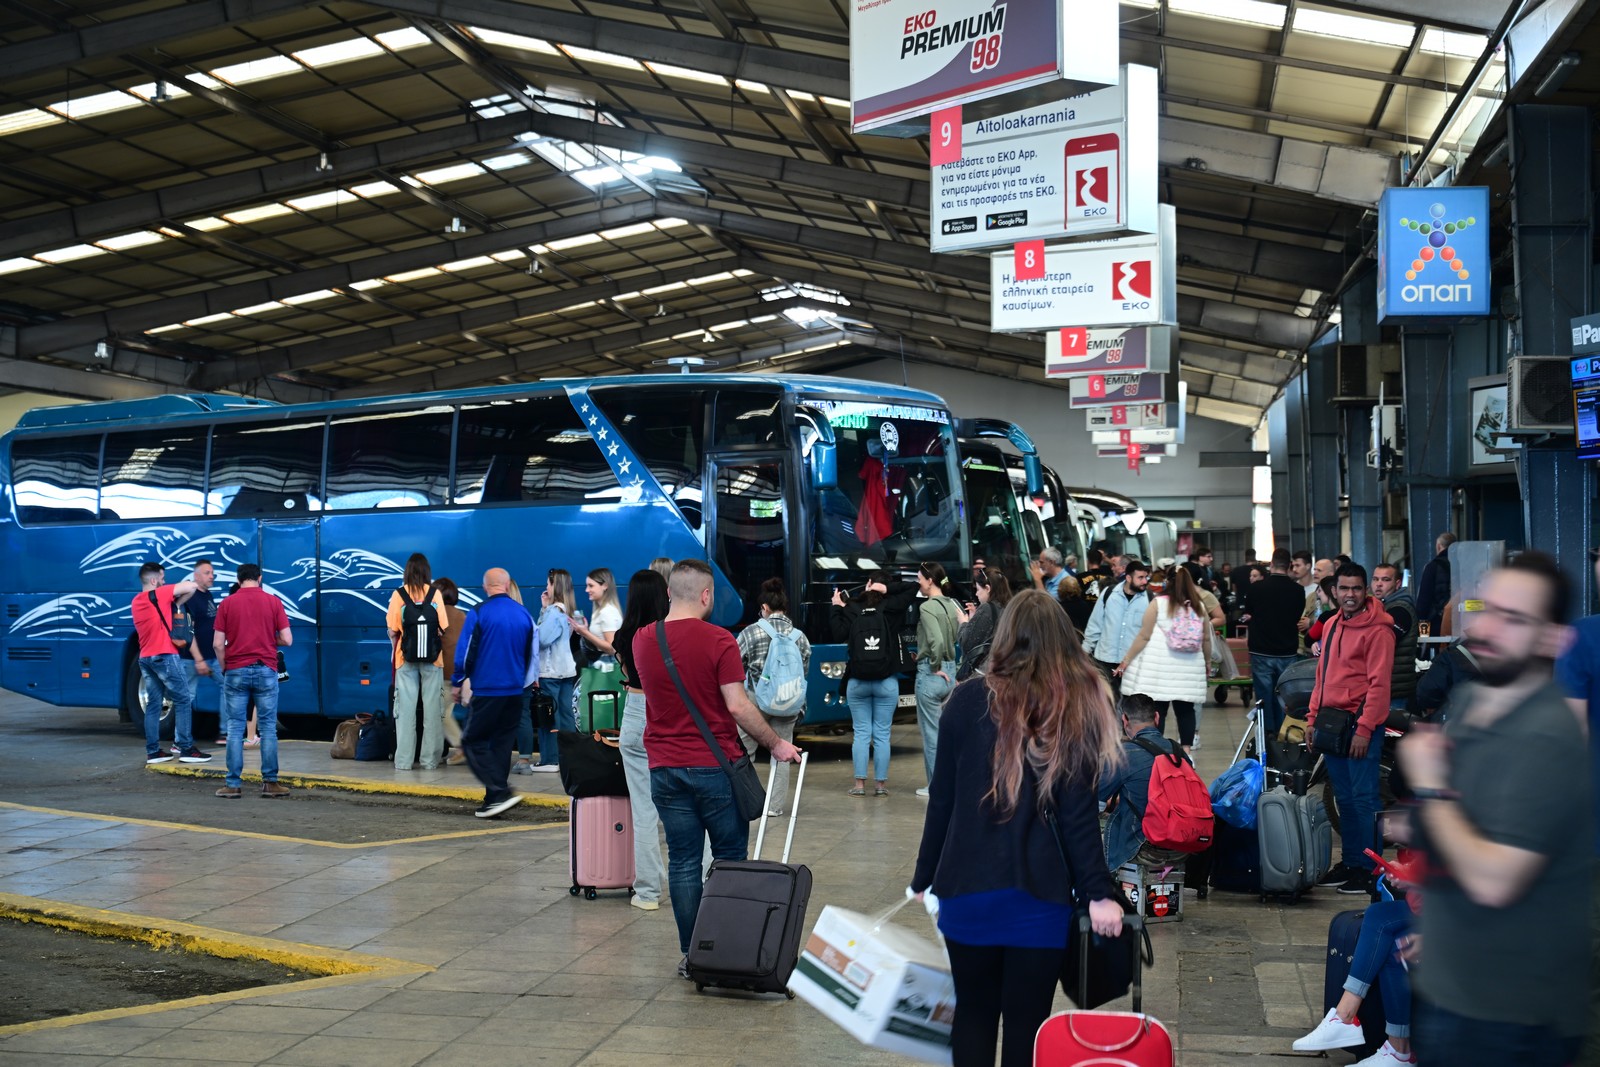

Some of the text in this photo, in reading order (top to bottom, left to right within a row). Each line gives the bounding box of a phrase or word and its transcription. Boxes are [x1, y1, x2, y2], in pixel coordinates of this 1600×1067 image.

[903, 9, 937, 35] EKO
[900, 7, 1005, 60] PREMIUM
[971, 34, 1001, 71] 98
[975, 107, 1076, 135] Aitoloakarnania
[941, 121, 951, 147] 9
[986, 154, 995, 164] το
[997, 150, 1016, 162] EKO
[941, 165, 1021, 185] για να είστε μόνιμα
[941, 174, 1046, 197] ενημερωμένοι για τα νέα
[941, 201, 955, 210] και
[956, 199, 968, 208] τις
[970, 191, 1018, 207] προσφορές
[1019, 191, 1034, 200] της
[1083, 206, 1107, 217] EKO
[951, 225, 962, 233] App
[962, 223, 975, 231] Store
[997, 217, 1026, 227] Google Play
[1024, 250, 1035, 268] 8
[1002, 283, 1094, 297] ελληνική εταιρεία
[1002, 299, 1055, 312] καυσίμων.
[1122, 301, 1150, 311] EKO
[1068, 333, 1079, 348] 7
[1086, 338, 1124, 350] EMIUM
[1107, 349, 1122, 362] 98
[1093, 380, 1100, 391] 6
[1125, 384, 1138, 395] 98
[1116, 409, 1122, 419] 5
[1122, 432, 1128, 441] 4
[1130, 446, 1136, 455] 3
[776, 676, 801, 702] NIKE
